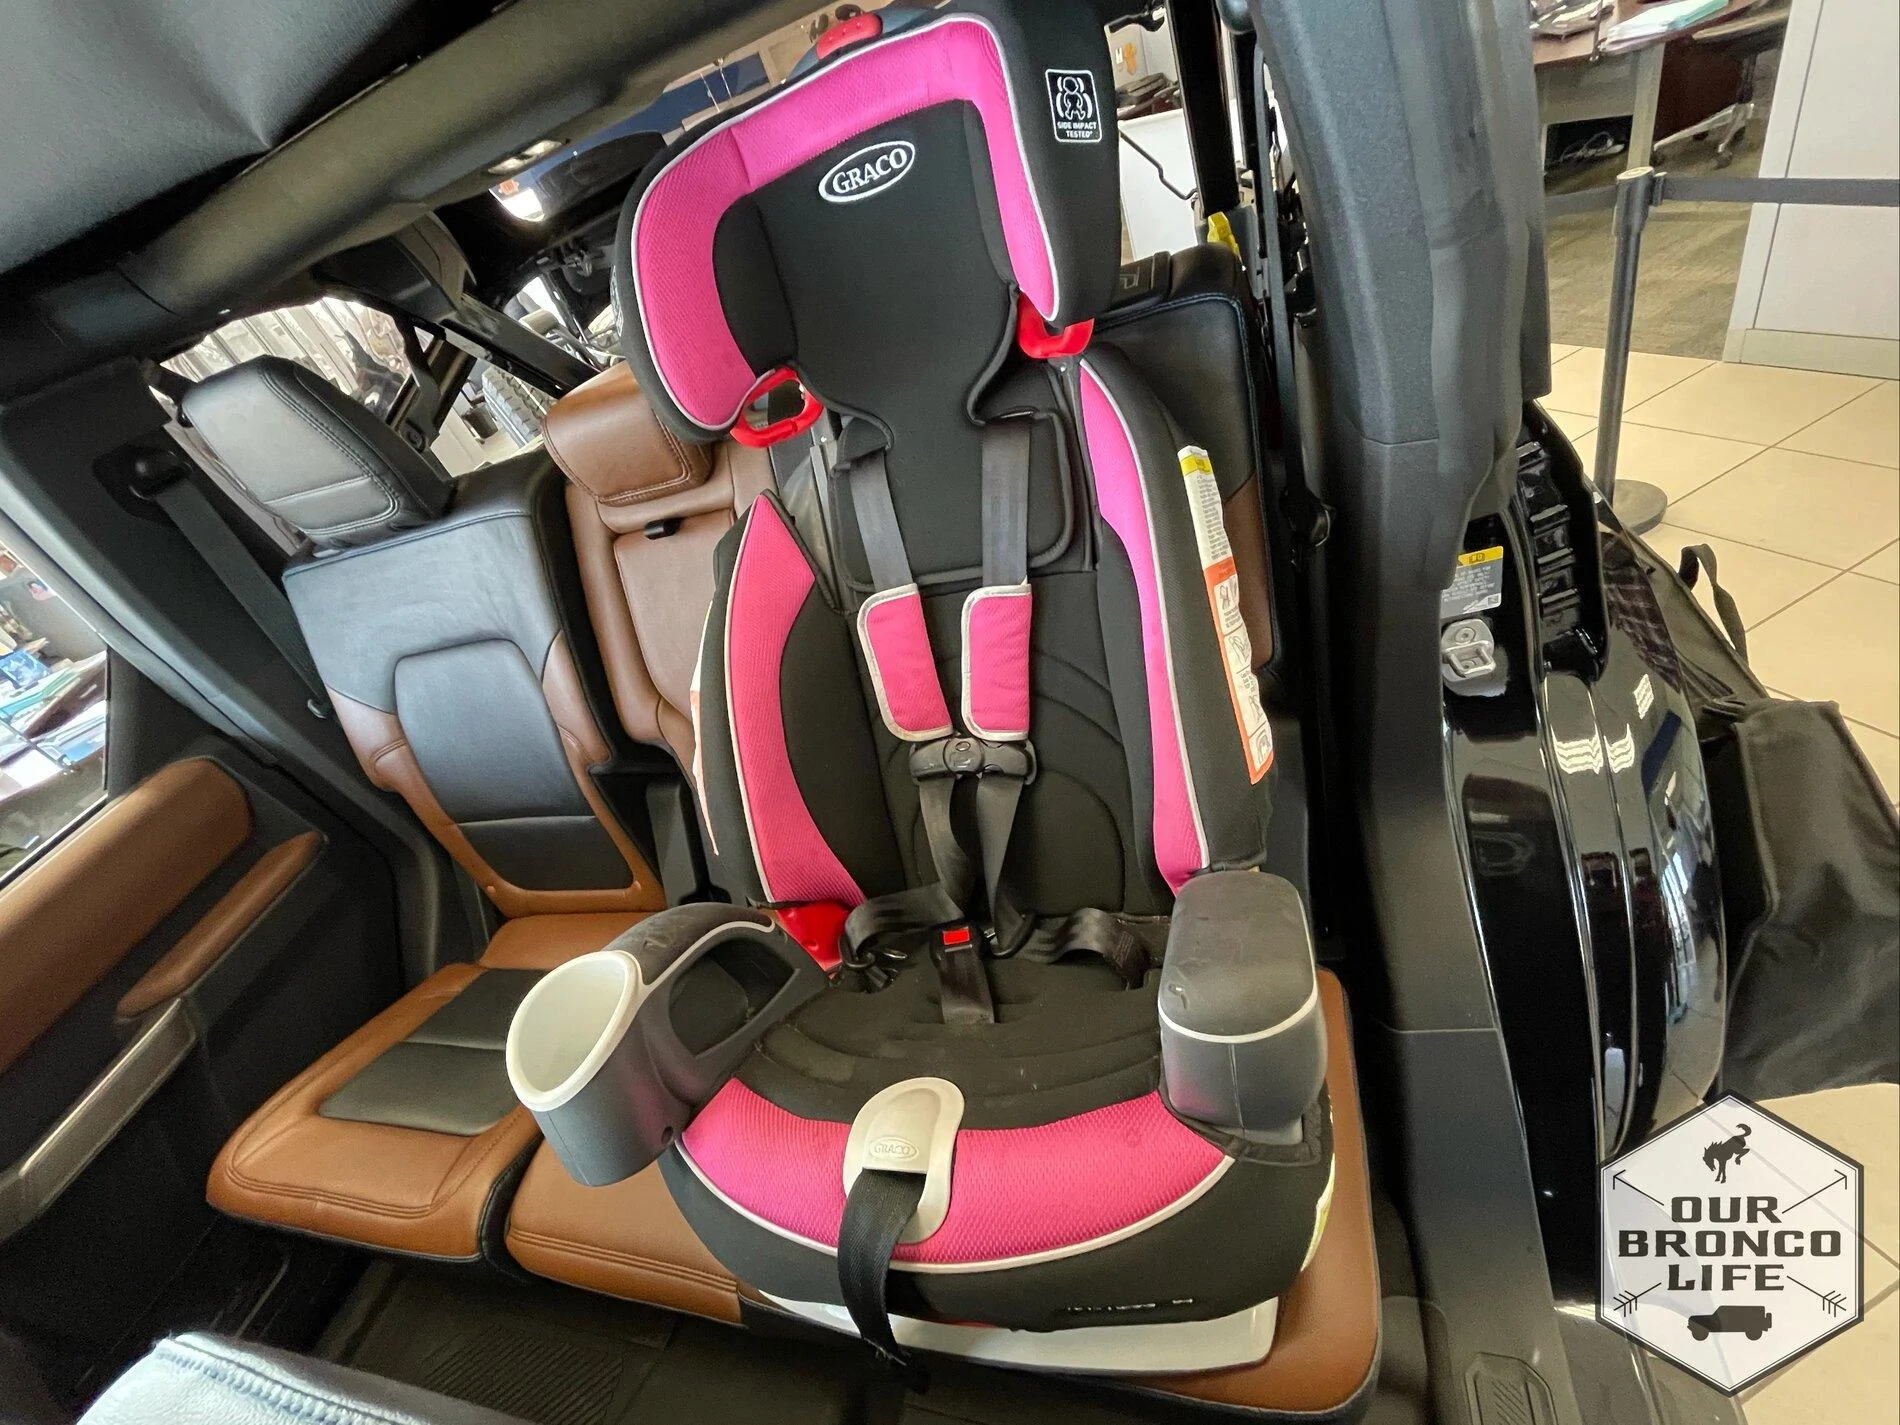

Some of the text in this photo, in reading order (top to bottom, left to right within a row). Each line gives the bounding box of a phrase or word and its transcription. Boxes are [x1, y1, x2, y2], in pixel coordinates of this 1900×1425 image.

[1057, 121, 1097, 129] SIDE IMPACT
[832, 147, 908, 194] GRACO
[875, 1143, 910, 1155] GRACO
